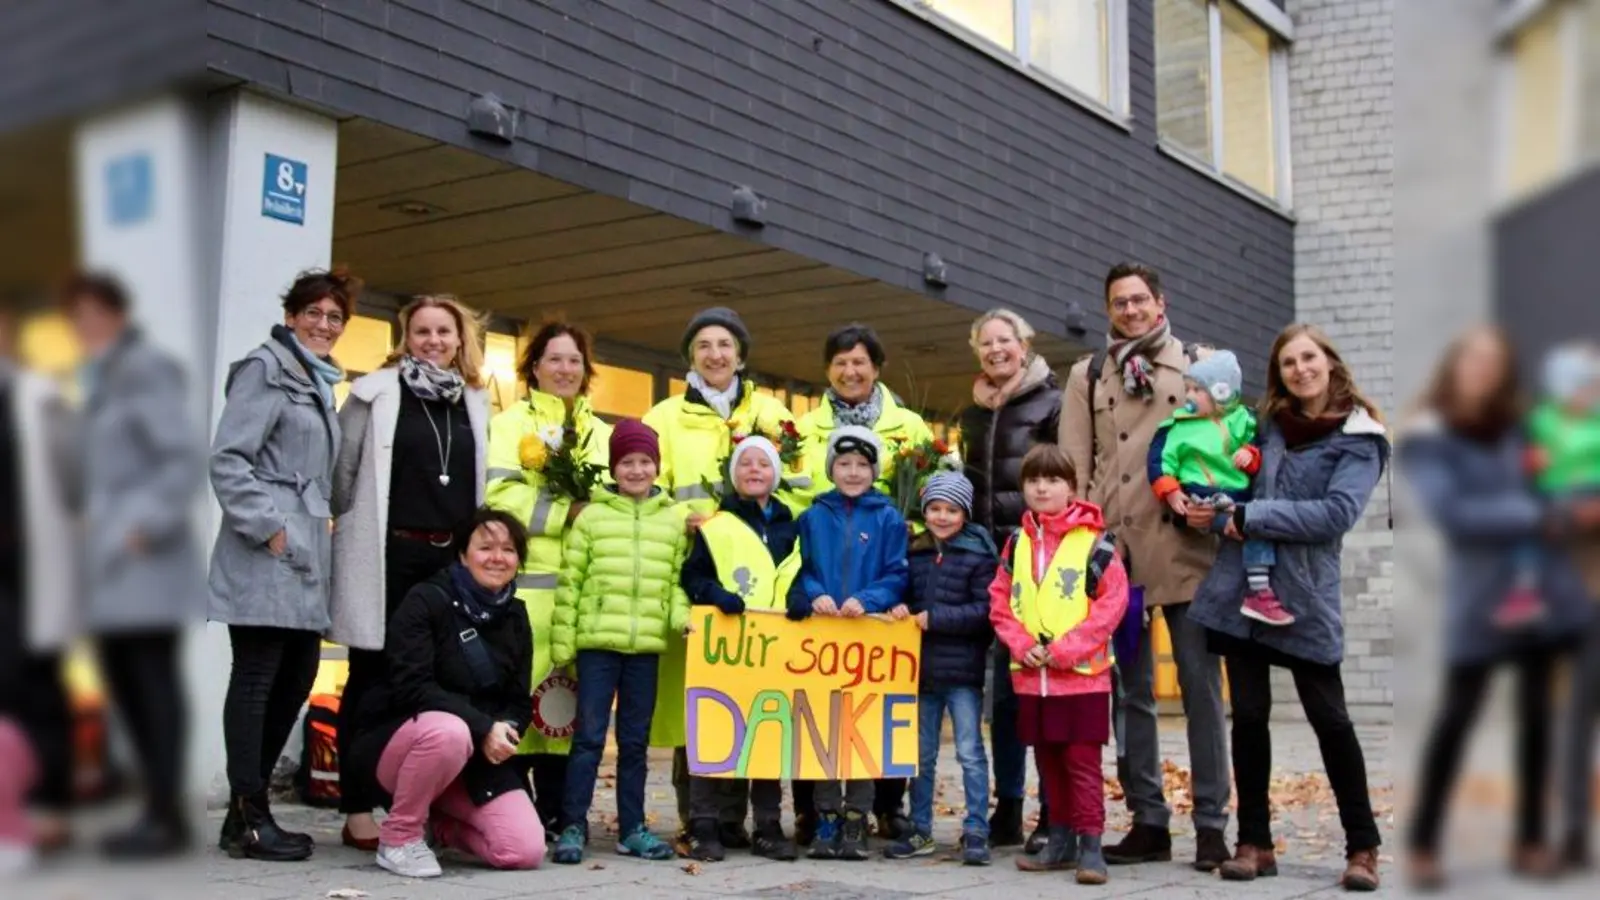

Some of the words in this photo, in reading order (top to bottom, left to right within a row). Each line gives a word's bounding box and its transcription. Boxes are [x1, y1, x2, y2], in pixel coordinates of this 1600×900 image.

[277, 161, 294, 192] 8
[703, 613, 779, 668] Wir
[785, 638, 918, 690] sagen
[686, 686, 917, 779] DANKE
